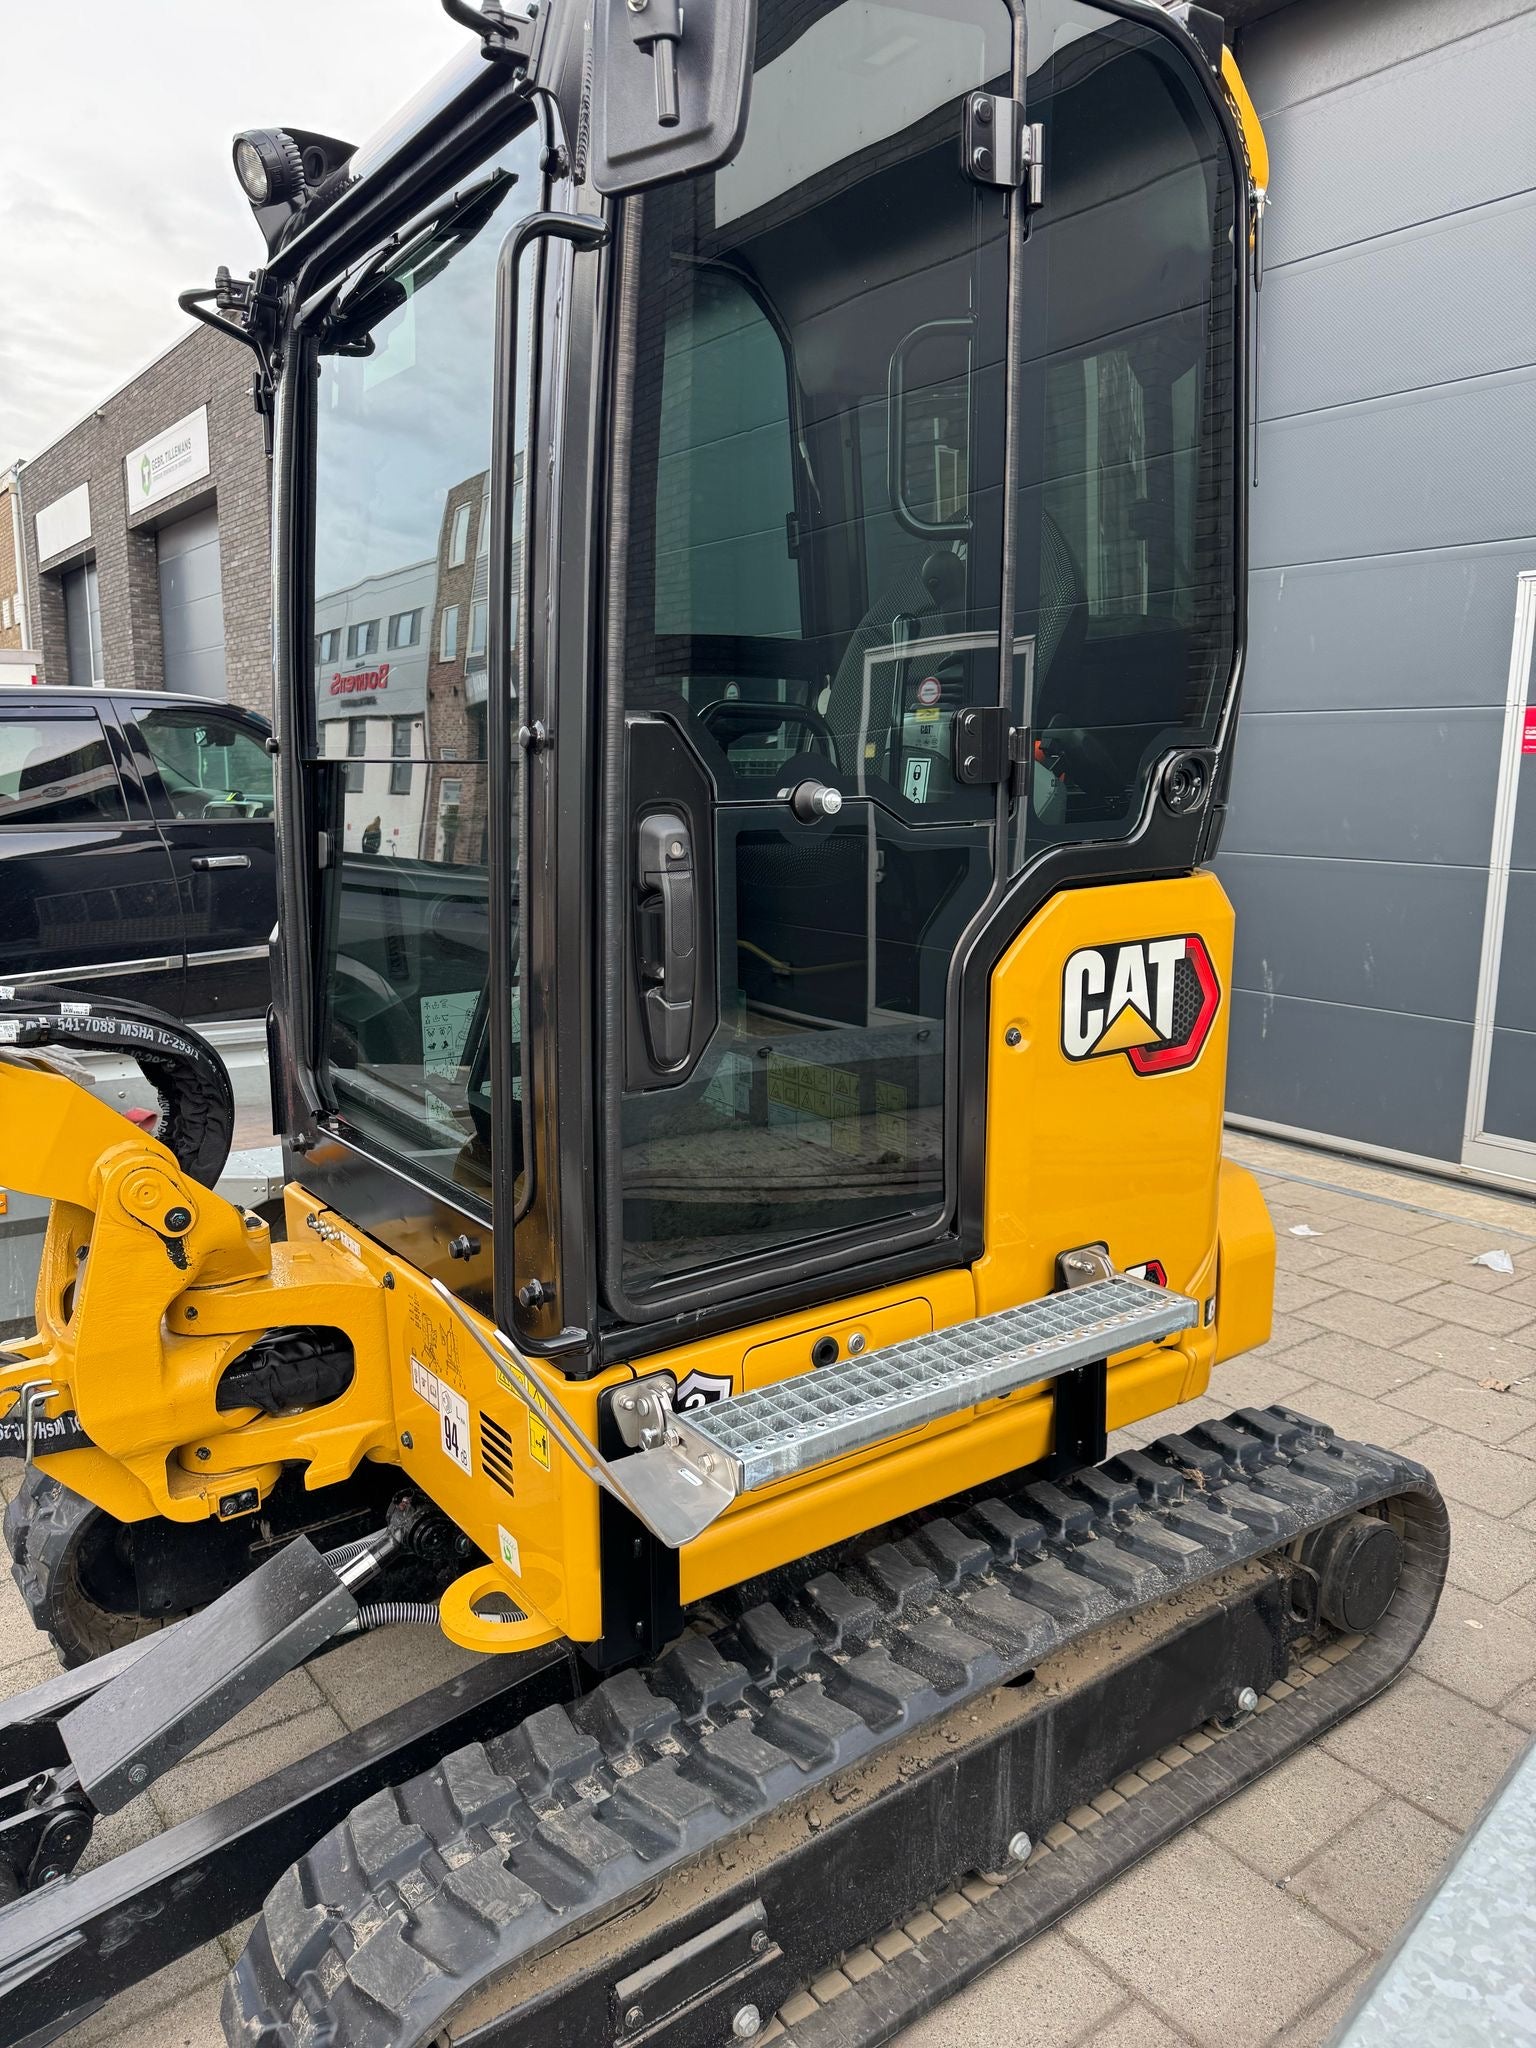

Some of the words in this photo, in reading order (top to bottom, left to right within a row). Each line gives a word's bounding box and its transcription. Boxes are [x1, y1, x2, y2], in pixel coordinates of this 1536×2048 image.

[165, 437, 192, 462] TILLEMANS
[1063, 938, 1186, 1057] CAT
[57, 1017, 116, 1034] 541-7088
[120, 1022, 154, 1041] MSHA
[444, 1415, 459, 1458] 94
